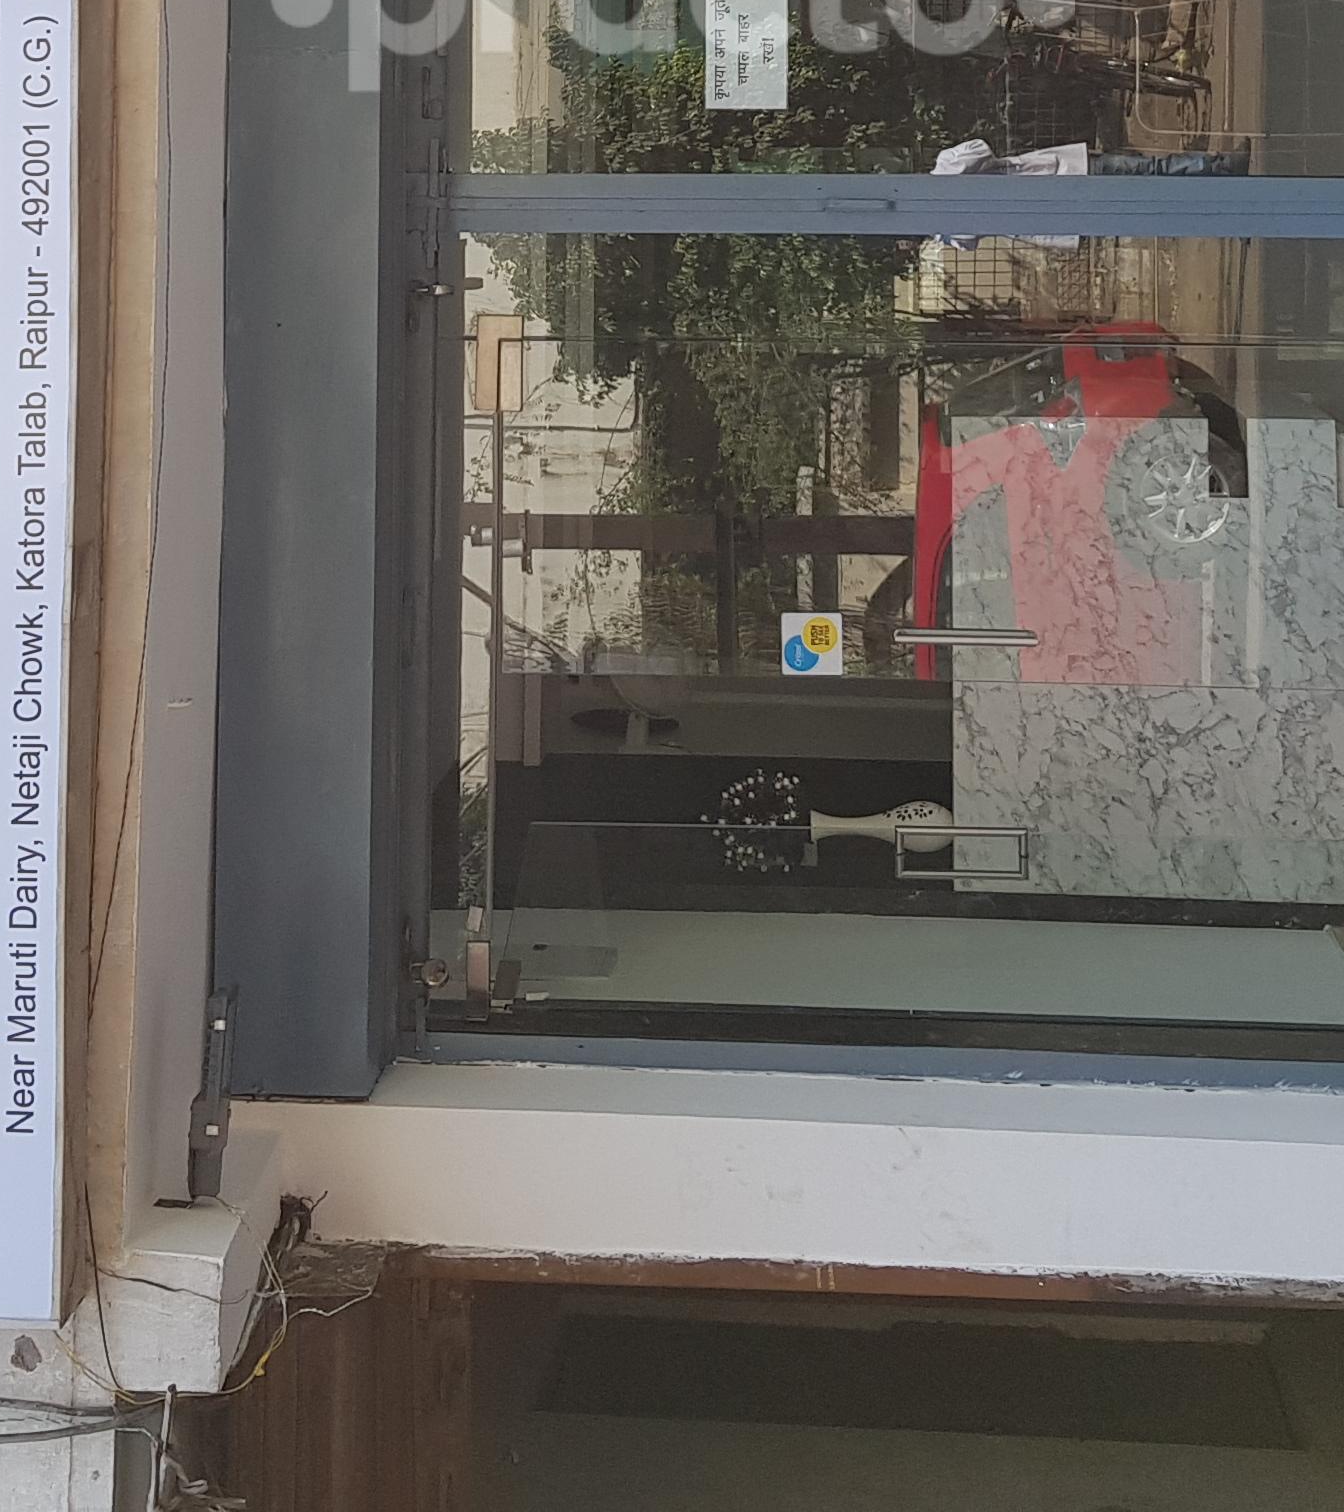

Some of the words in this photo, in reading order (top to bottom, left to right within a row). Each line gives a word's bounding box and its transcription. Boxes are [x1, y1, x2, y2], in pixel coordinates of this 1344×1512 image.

[711, 0, 730, 21] जूते
[711, 29, 726, 58] अपने
[738, 14, 750, 44] बाहर
[21, 14, 58, 110] (C.G.)
[714, 65, 730, 101] कृपया
[737, 50, 750, 86] चप्पल
[20, 122, 51, 236] 492001
[18, 265, 59, 371] Raipur
[17, 382, 53, 476] Talab,
[16, 486, 47, 590] Katora
[12, 603, 49, 723] Chowk,
[9, 733, 49, 826] Netaji
[7, 838, 47, 930] Dairy,
[6, 940, 38, 1044] Maruti
[5, 1054, 37, 1134] Near
